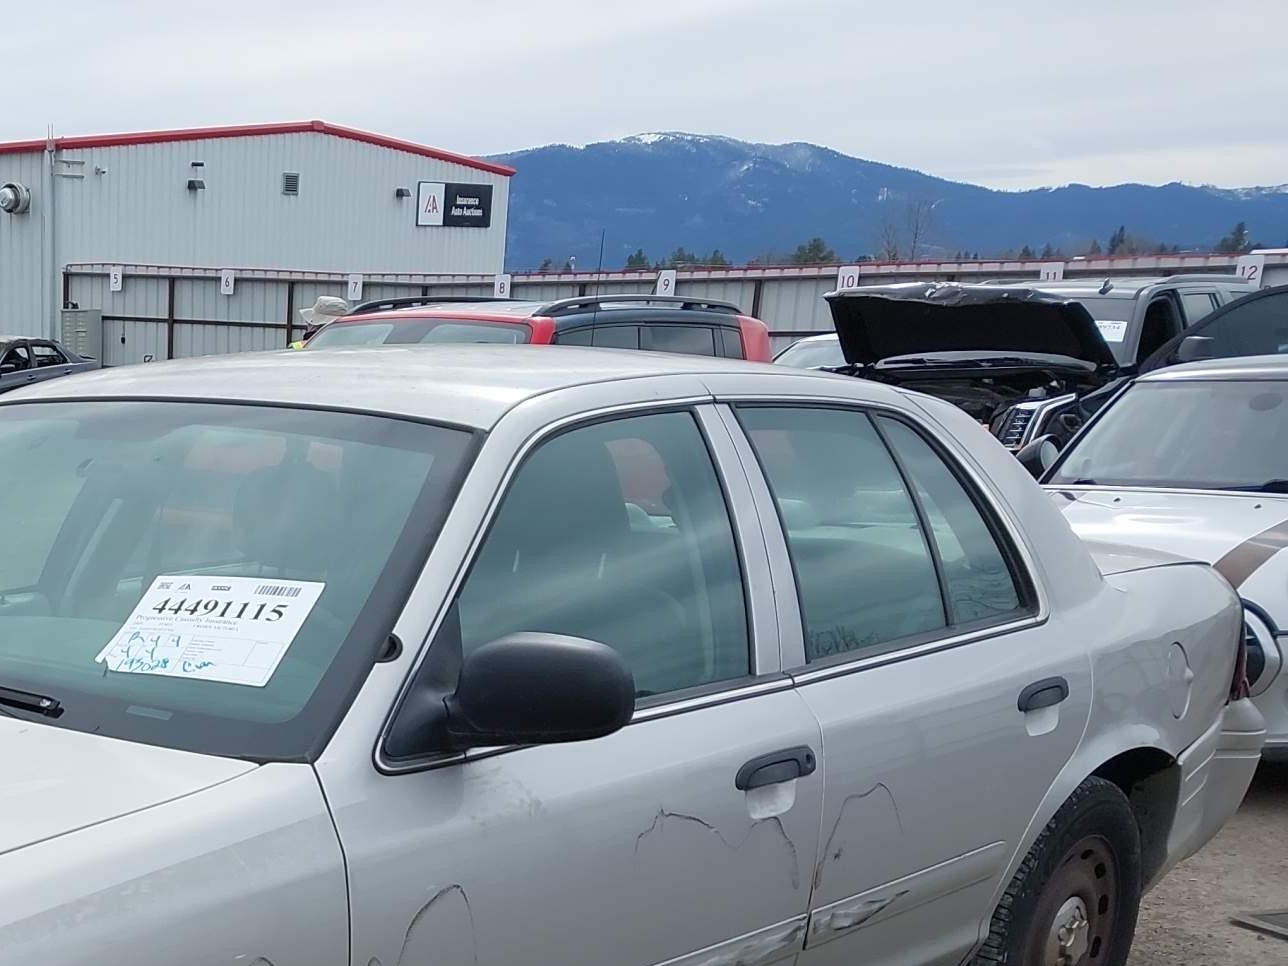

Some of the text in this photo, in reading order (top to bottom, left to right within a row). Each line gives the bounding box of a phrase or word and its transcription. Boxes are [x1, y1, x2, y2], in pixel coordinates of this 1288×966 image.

[113, 273, 119, 284] 5
[1241, 265, 1258, 281] 12
[224, 278, 230, 288] 6
[352, 281, 359, 293] 7
[662, 278, 670, 291] 9
[841, 275, 855, 288] 10
[499, 282, 506, 294] 8
[152, 597, 289, 622] 44491115
